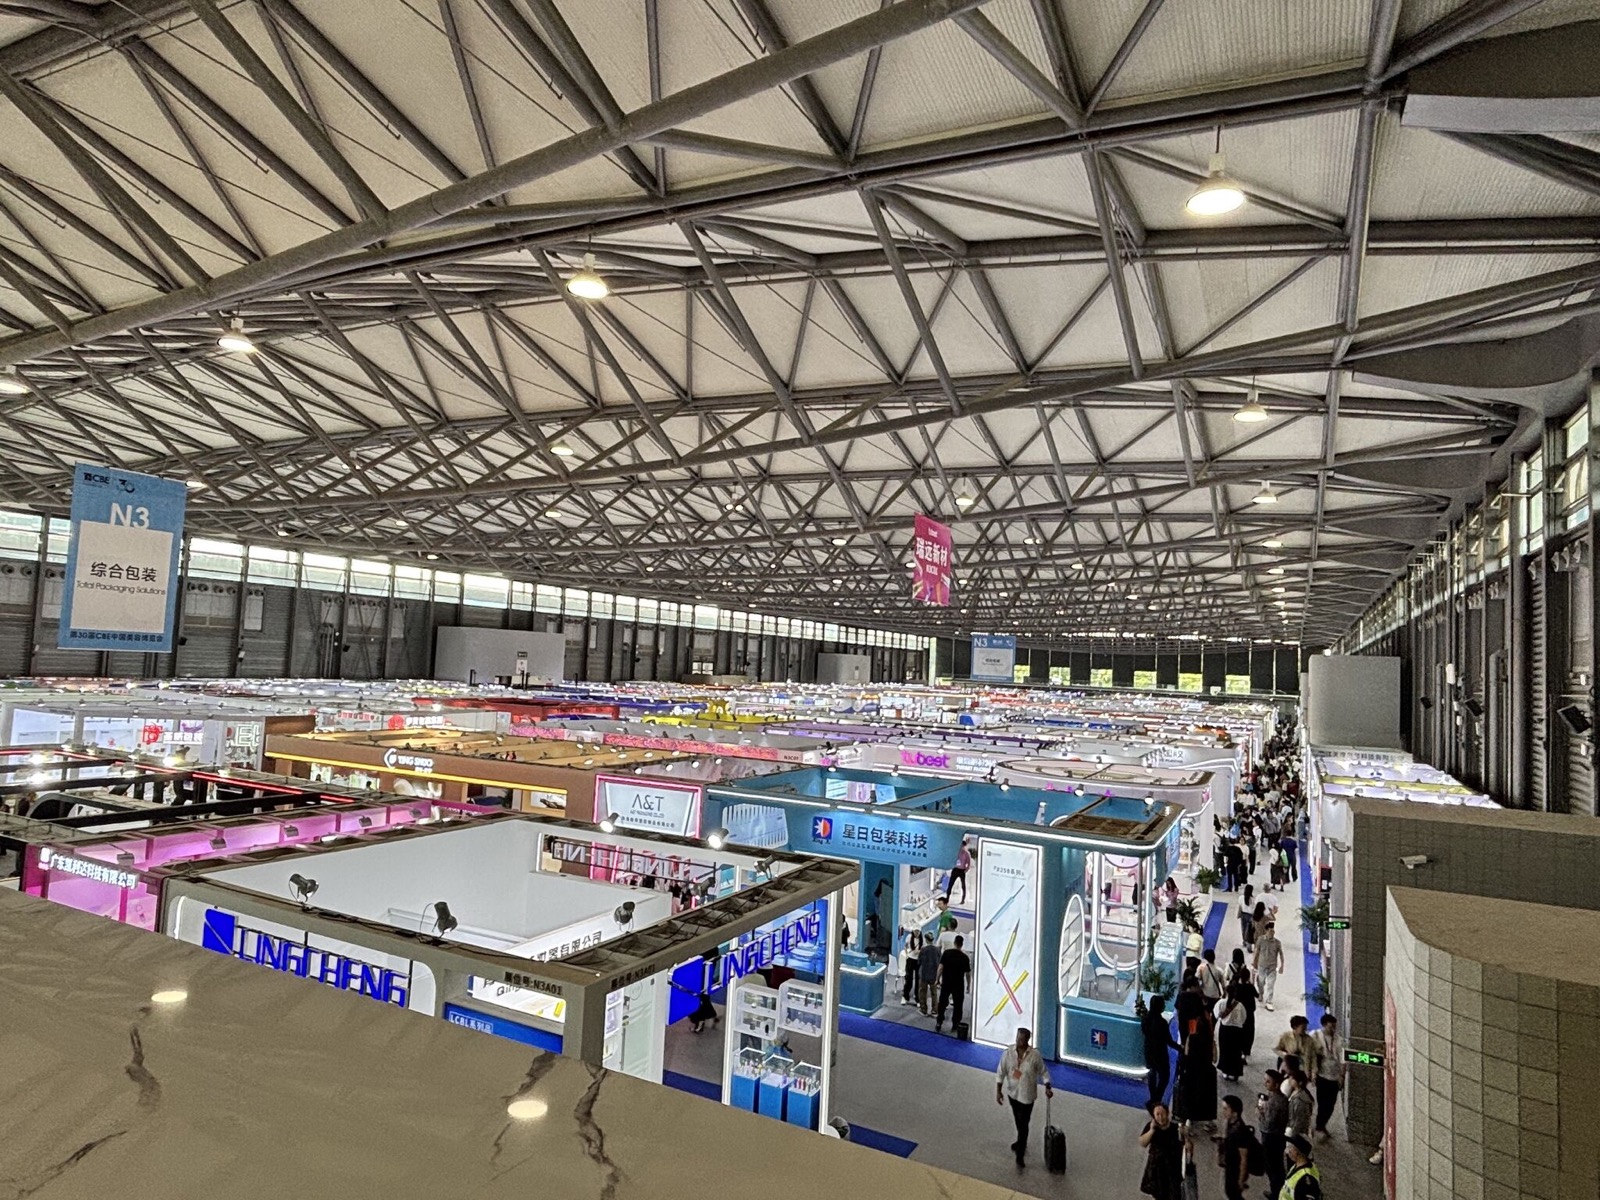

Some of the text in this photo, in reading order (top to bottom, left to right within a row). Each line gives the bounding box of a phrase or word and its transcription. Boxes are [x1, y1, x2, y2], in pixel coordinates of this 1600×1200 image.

[110, 502, 150, 529] N3
[90, 561, 157, 583] 综合包装
[96, 582, 135, 595] Packaging
[136, 585, 166, 596] Solutions
[973, 637, 988, 647] N3
[631, 793, 664, 812] A&T
[843, 824, 928, 850] 星日包装科技
[705, 911, 821, 996] LINGCHENG
